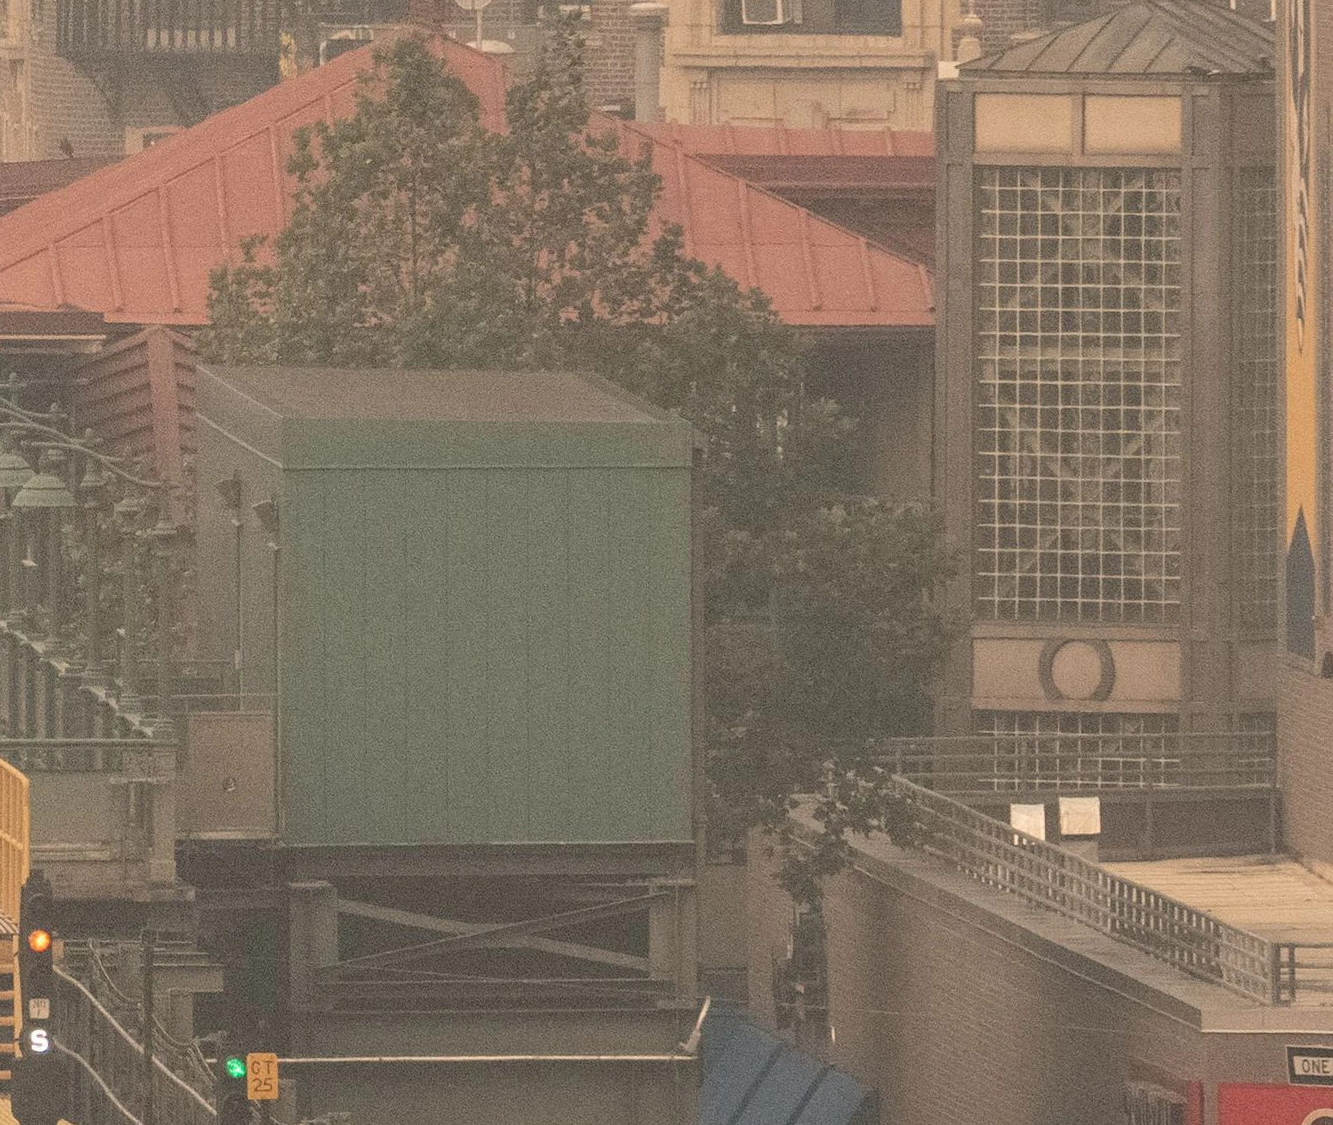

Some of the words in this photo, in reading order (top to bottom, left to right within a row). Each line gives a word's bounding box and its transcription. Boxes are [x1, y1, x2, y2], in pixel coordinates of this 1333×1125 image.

[30, 1029, 49, 1052] S
[1301, 1058, 1330, 1074] ONE
[252, 1077, 274, 1092] 25
